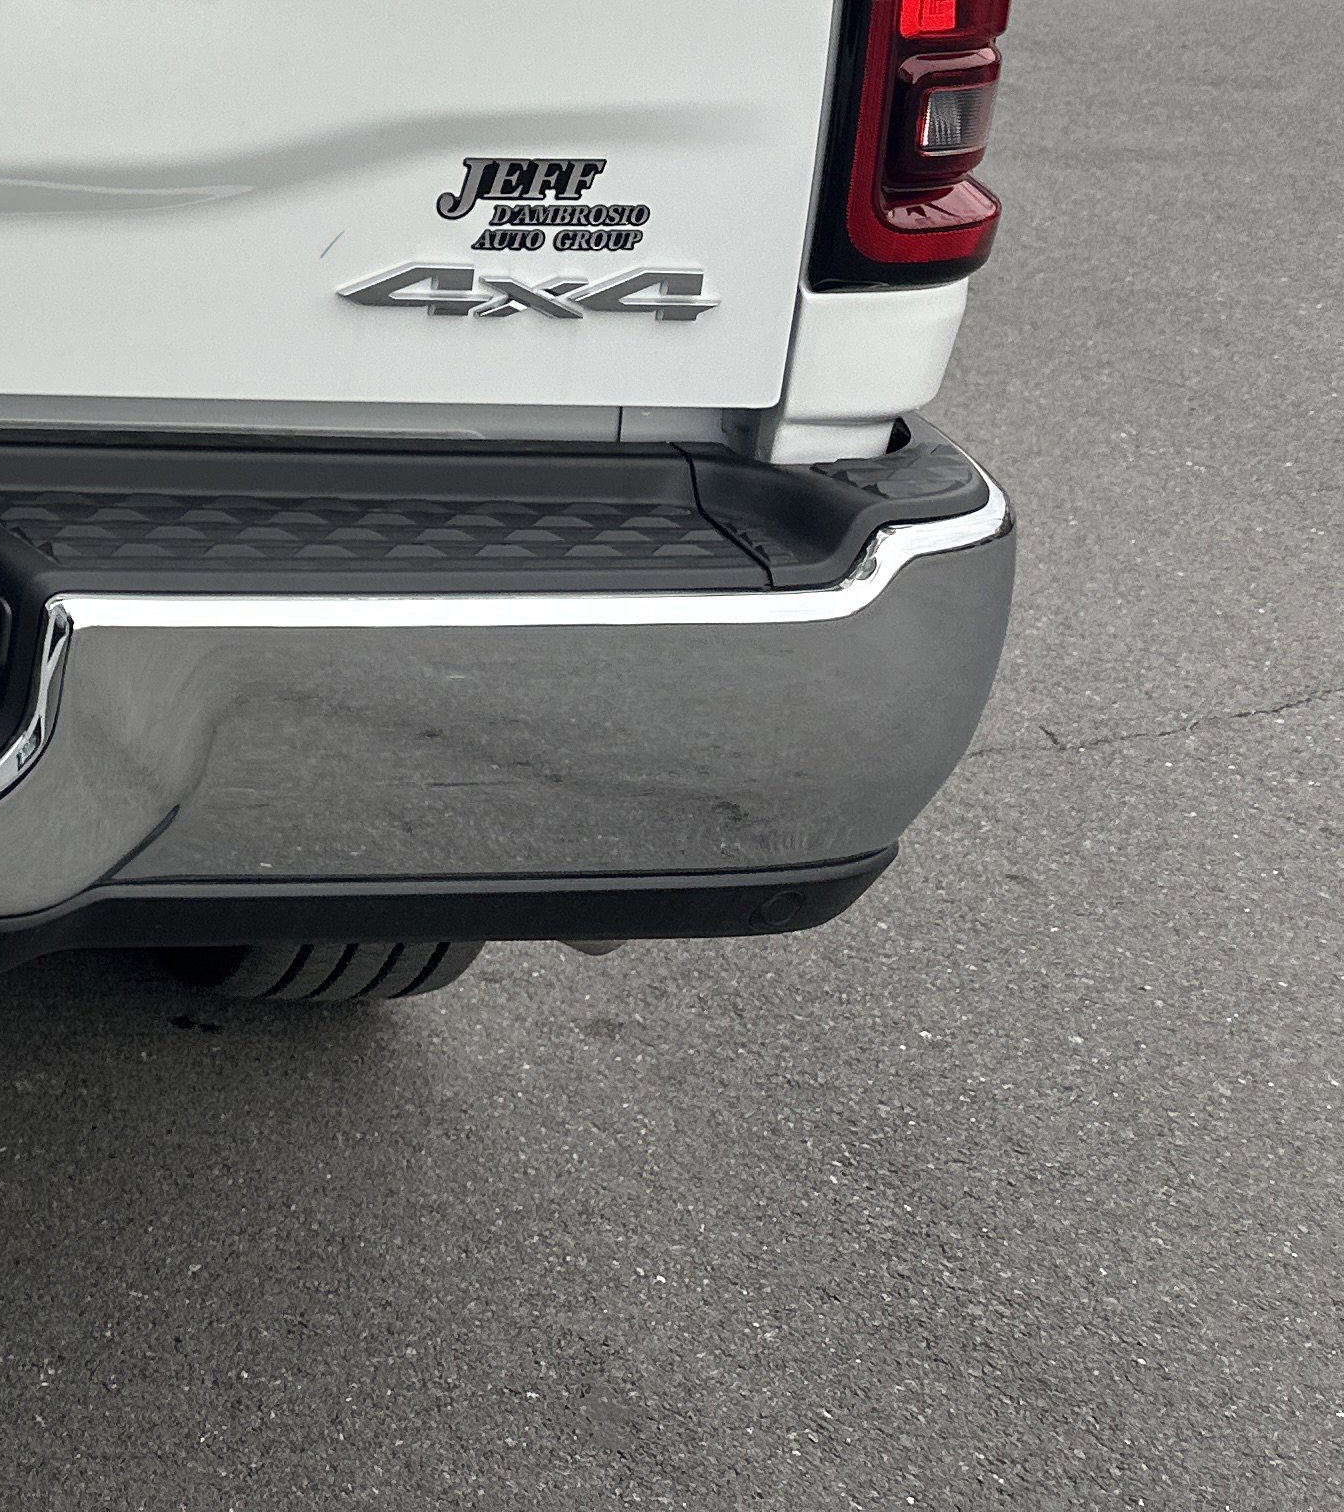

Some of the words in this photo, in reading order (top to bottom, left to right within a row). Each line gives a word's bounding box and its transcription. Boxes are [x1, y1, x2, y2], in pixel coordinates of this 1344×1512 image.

[436, 157, 607, 220] JEFF
[488, 204, 651, 227] D'AMBROSIO
[471, 229, 545, 251] AUTO
[553, 229, 644, 252] GROUP
